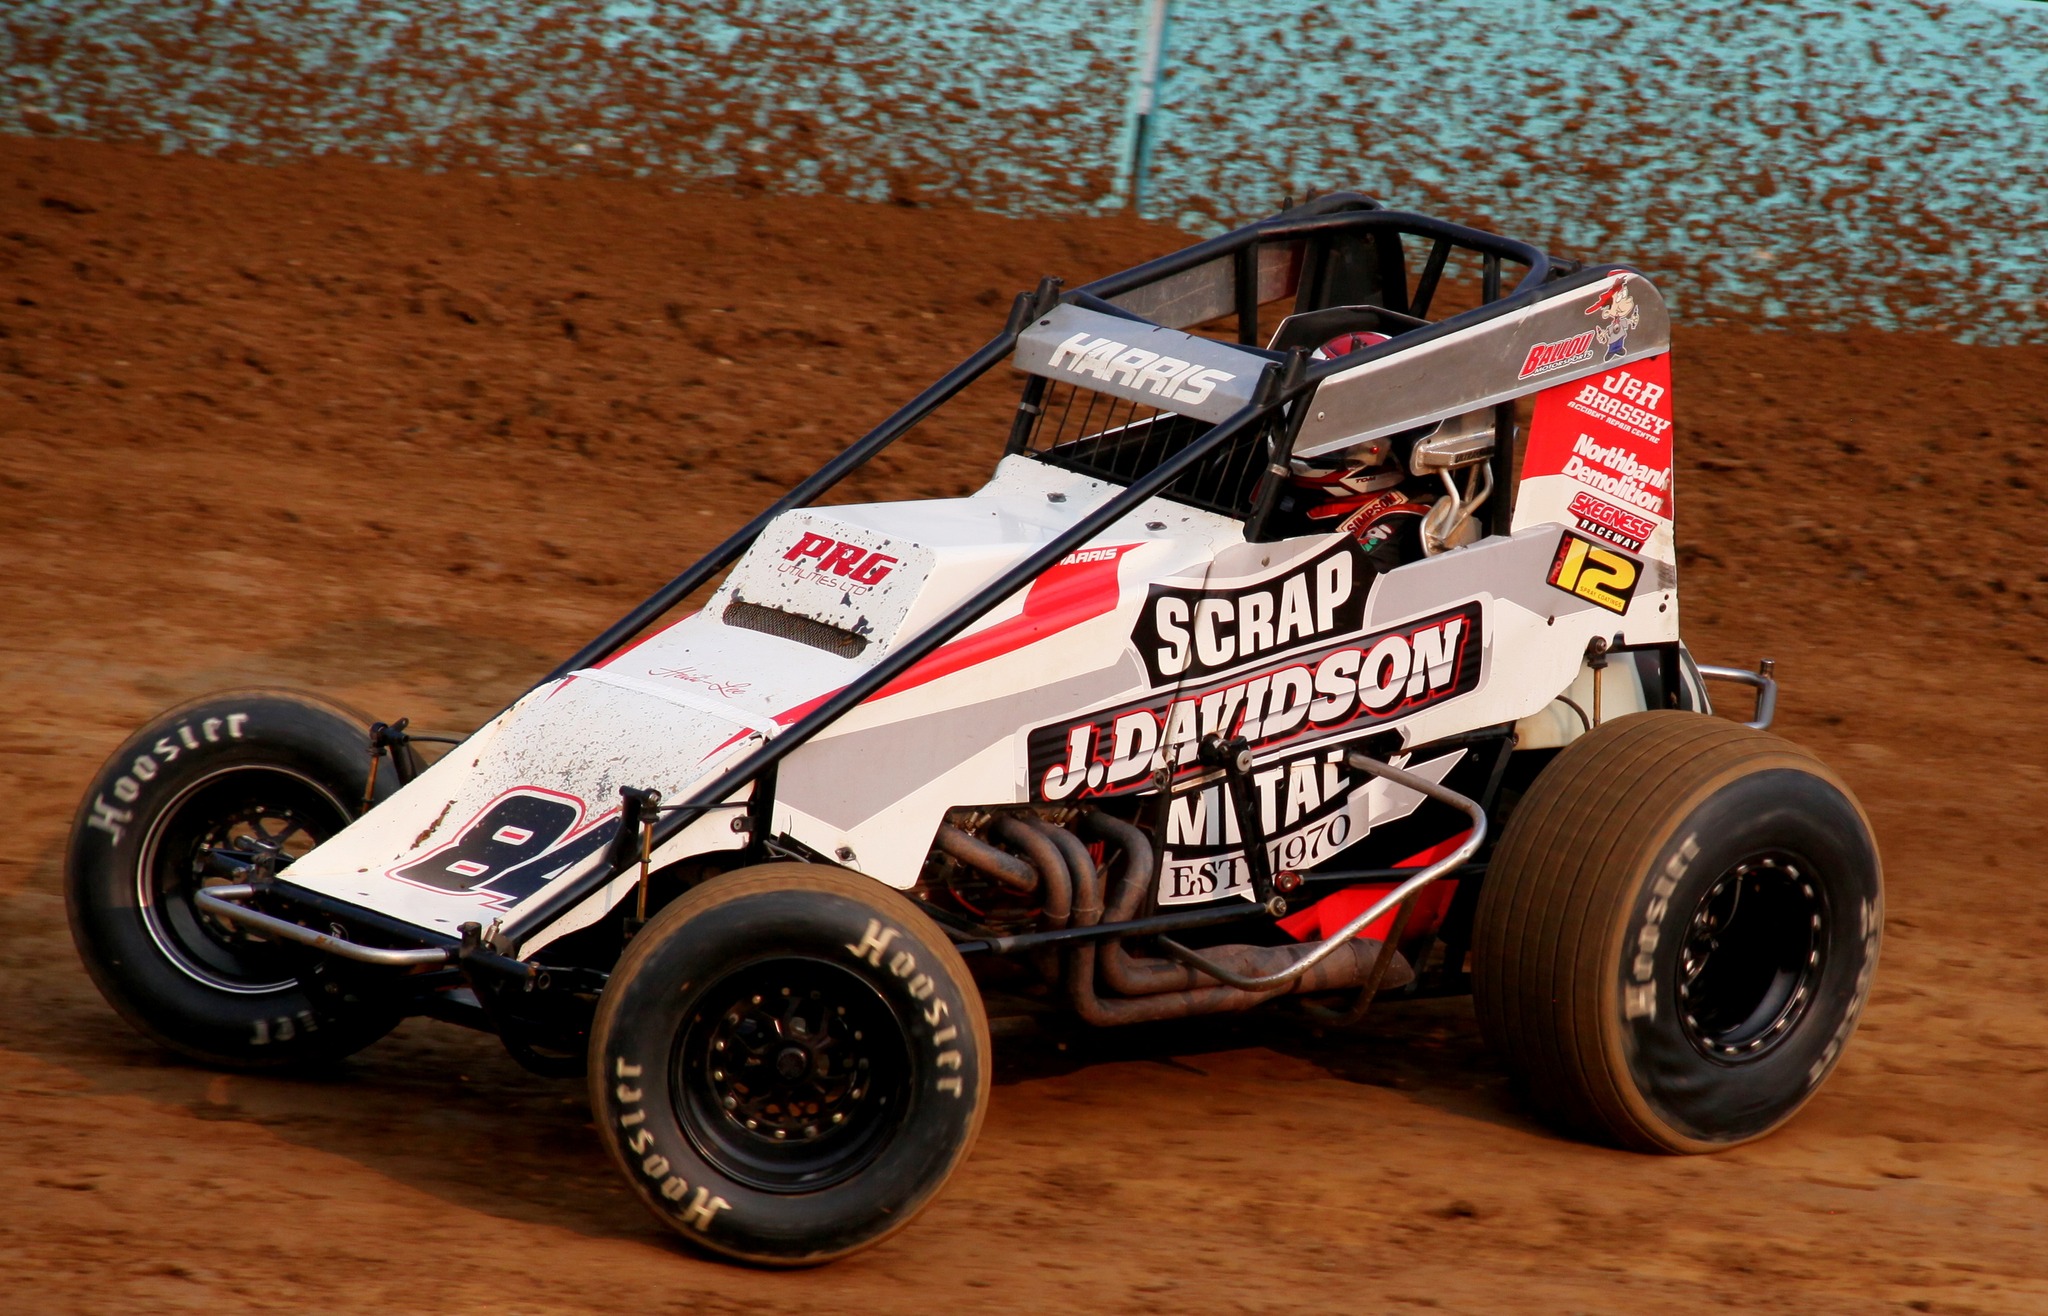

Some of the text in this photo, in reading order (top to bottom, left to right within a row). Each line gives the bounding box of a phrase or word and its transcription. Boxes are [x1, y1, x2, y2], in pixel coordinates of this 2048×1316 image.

[1048, 332, 1237, 405] HARRIS
[1520, 333, 1594, 376] BALLOU
[1534, 350, 1593, 374] MOTORSPORTS
[1575, 384, 1672, 435] BRASSEY
[1602, 371, 1665, 410] J&R
[1567, 401, 1661, 444] ACCIDENT REPAIR CENTRE
[1561, 455, 1665, 513] Demolition
[1572, 433, 1671, 491] Northbank
[1346, 493, 1397, 533] SIMPSON
[1571, 493, 1654, 539] SKEGNESS
[1580, 519, 1640, 550] RACEWAY
[777, 562, 868, 596] UTILITIES LTD
[782, 531, 899, 586] PRG
[1055, 548, 1118, 567] ARRIS
[1549, 535, 1573, 585] PROJECT
[1556, 537, 1636, 612] 12
[1156, 550, 1354, 677] SCRAP
[1580, 586, 1622, 608] SPRAY COATINGS
[87, 712, 249, 847] Hoosier
[1269, 814, 1352, 877] 1970
[844, 917, 963, 1099] Hoosier
[615, 1057, 733, 1232] Hoosier
